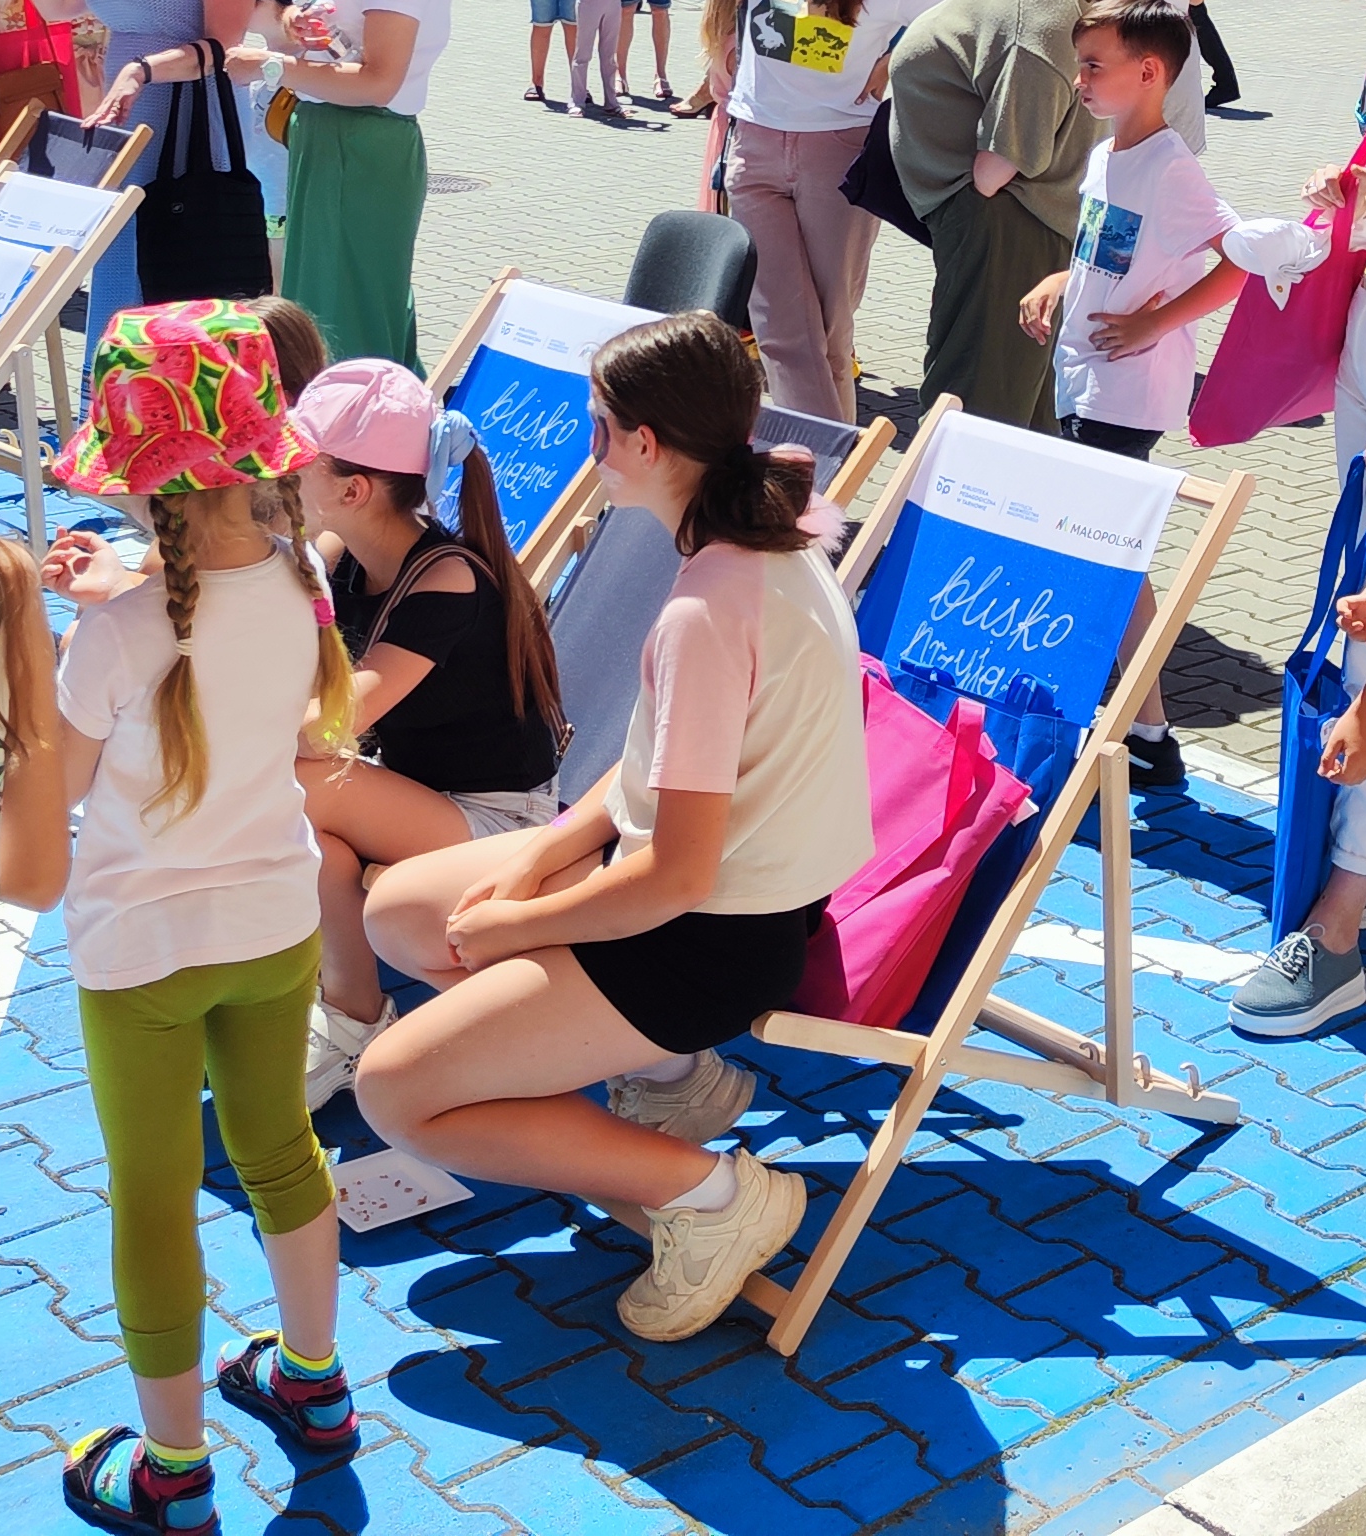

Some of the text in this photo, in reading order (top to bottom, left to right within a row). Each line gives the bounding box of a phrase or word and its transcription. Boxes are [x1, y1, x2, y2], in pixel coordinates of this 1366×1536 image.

[481, 381, 578, 451] blisko
[1070, 523, 1143, 551] MAŁOPOLSKA
[929, 555, 1074, 652] blisko
